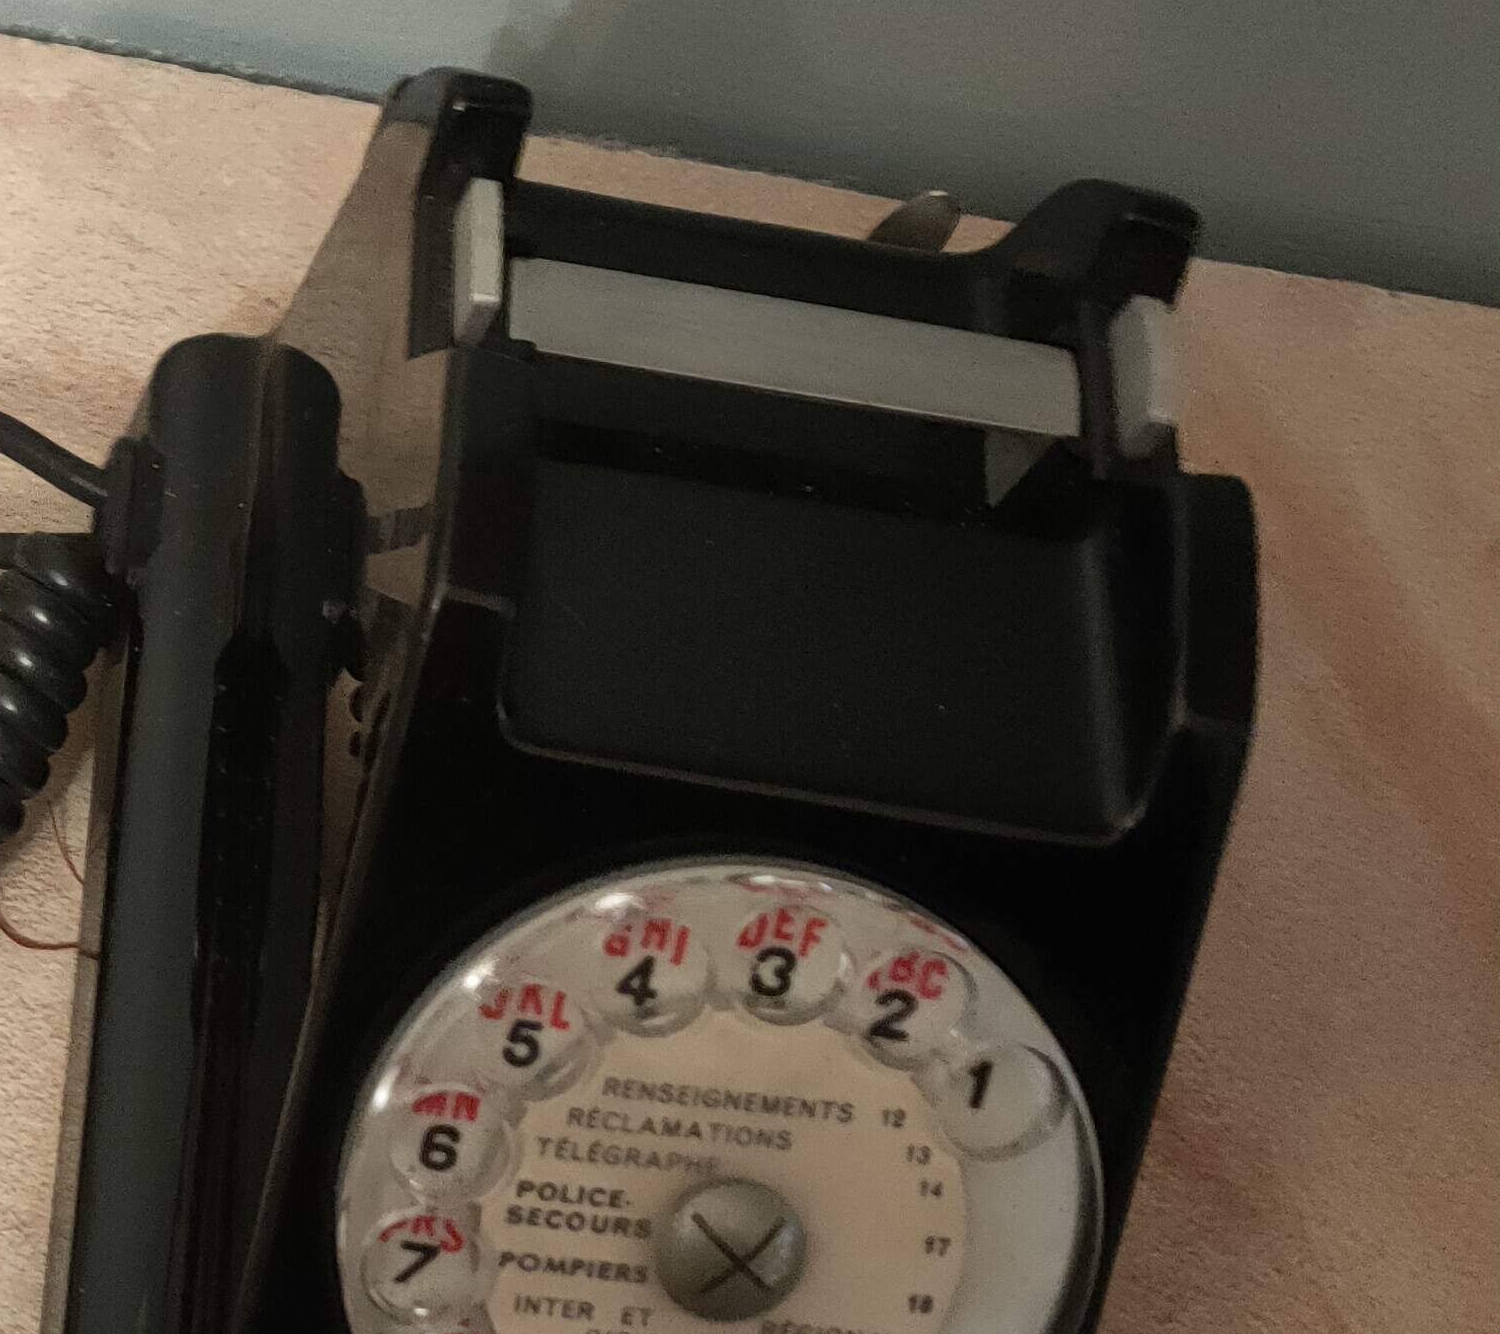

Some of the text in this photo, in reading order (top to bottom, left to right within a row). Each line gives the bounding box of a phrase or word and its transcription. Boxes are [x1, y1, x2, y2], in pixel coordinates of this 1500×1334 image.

[617, 956, 658, 1005] 4
[751, 946, 796, 997] 3
[869, 989, 917, 1041] 2
[503, 1019, 544, 1068] 5
[602, 1076, 906, 1128] RENSEIGNEMENTS 12
[969, 1060, 993, 1109] 1
[419, 1124, 461, 1170] 6
[566, 1105, 931, 1165] RÉCLAMATIONS 13
[920, 1180, 943, 1198] 14
[506, 1204, 951, 1257] SECOURS 17
[395, 1241, 439, 1283] 7
[499, 1251, 647, 1283] POMPIERS
[515, 1294, 595, 1320] INTER
[621, 1306, 653, 1327] ET
